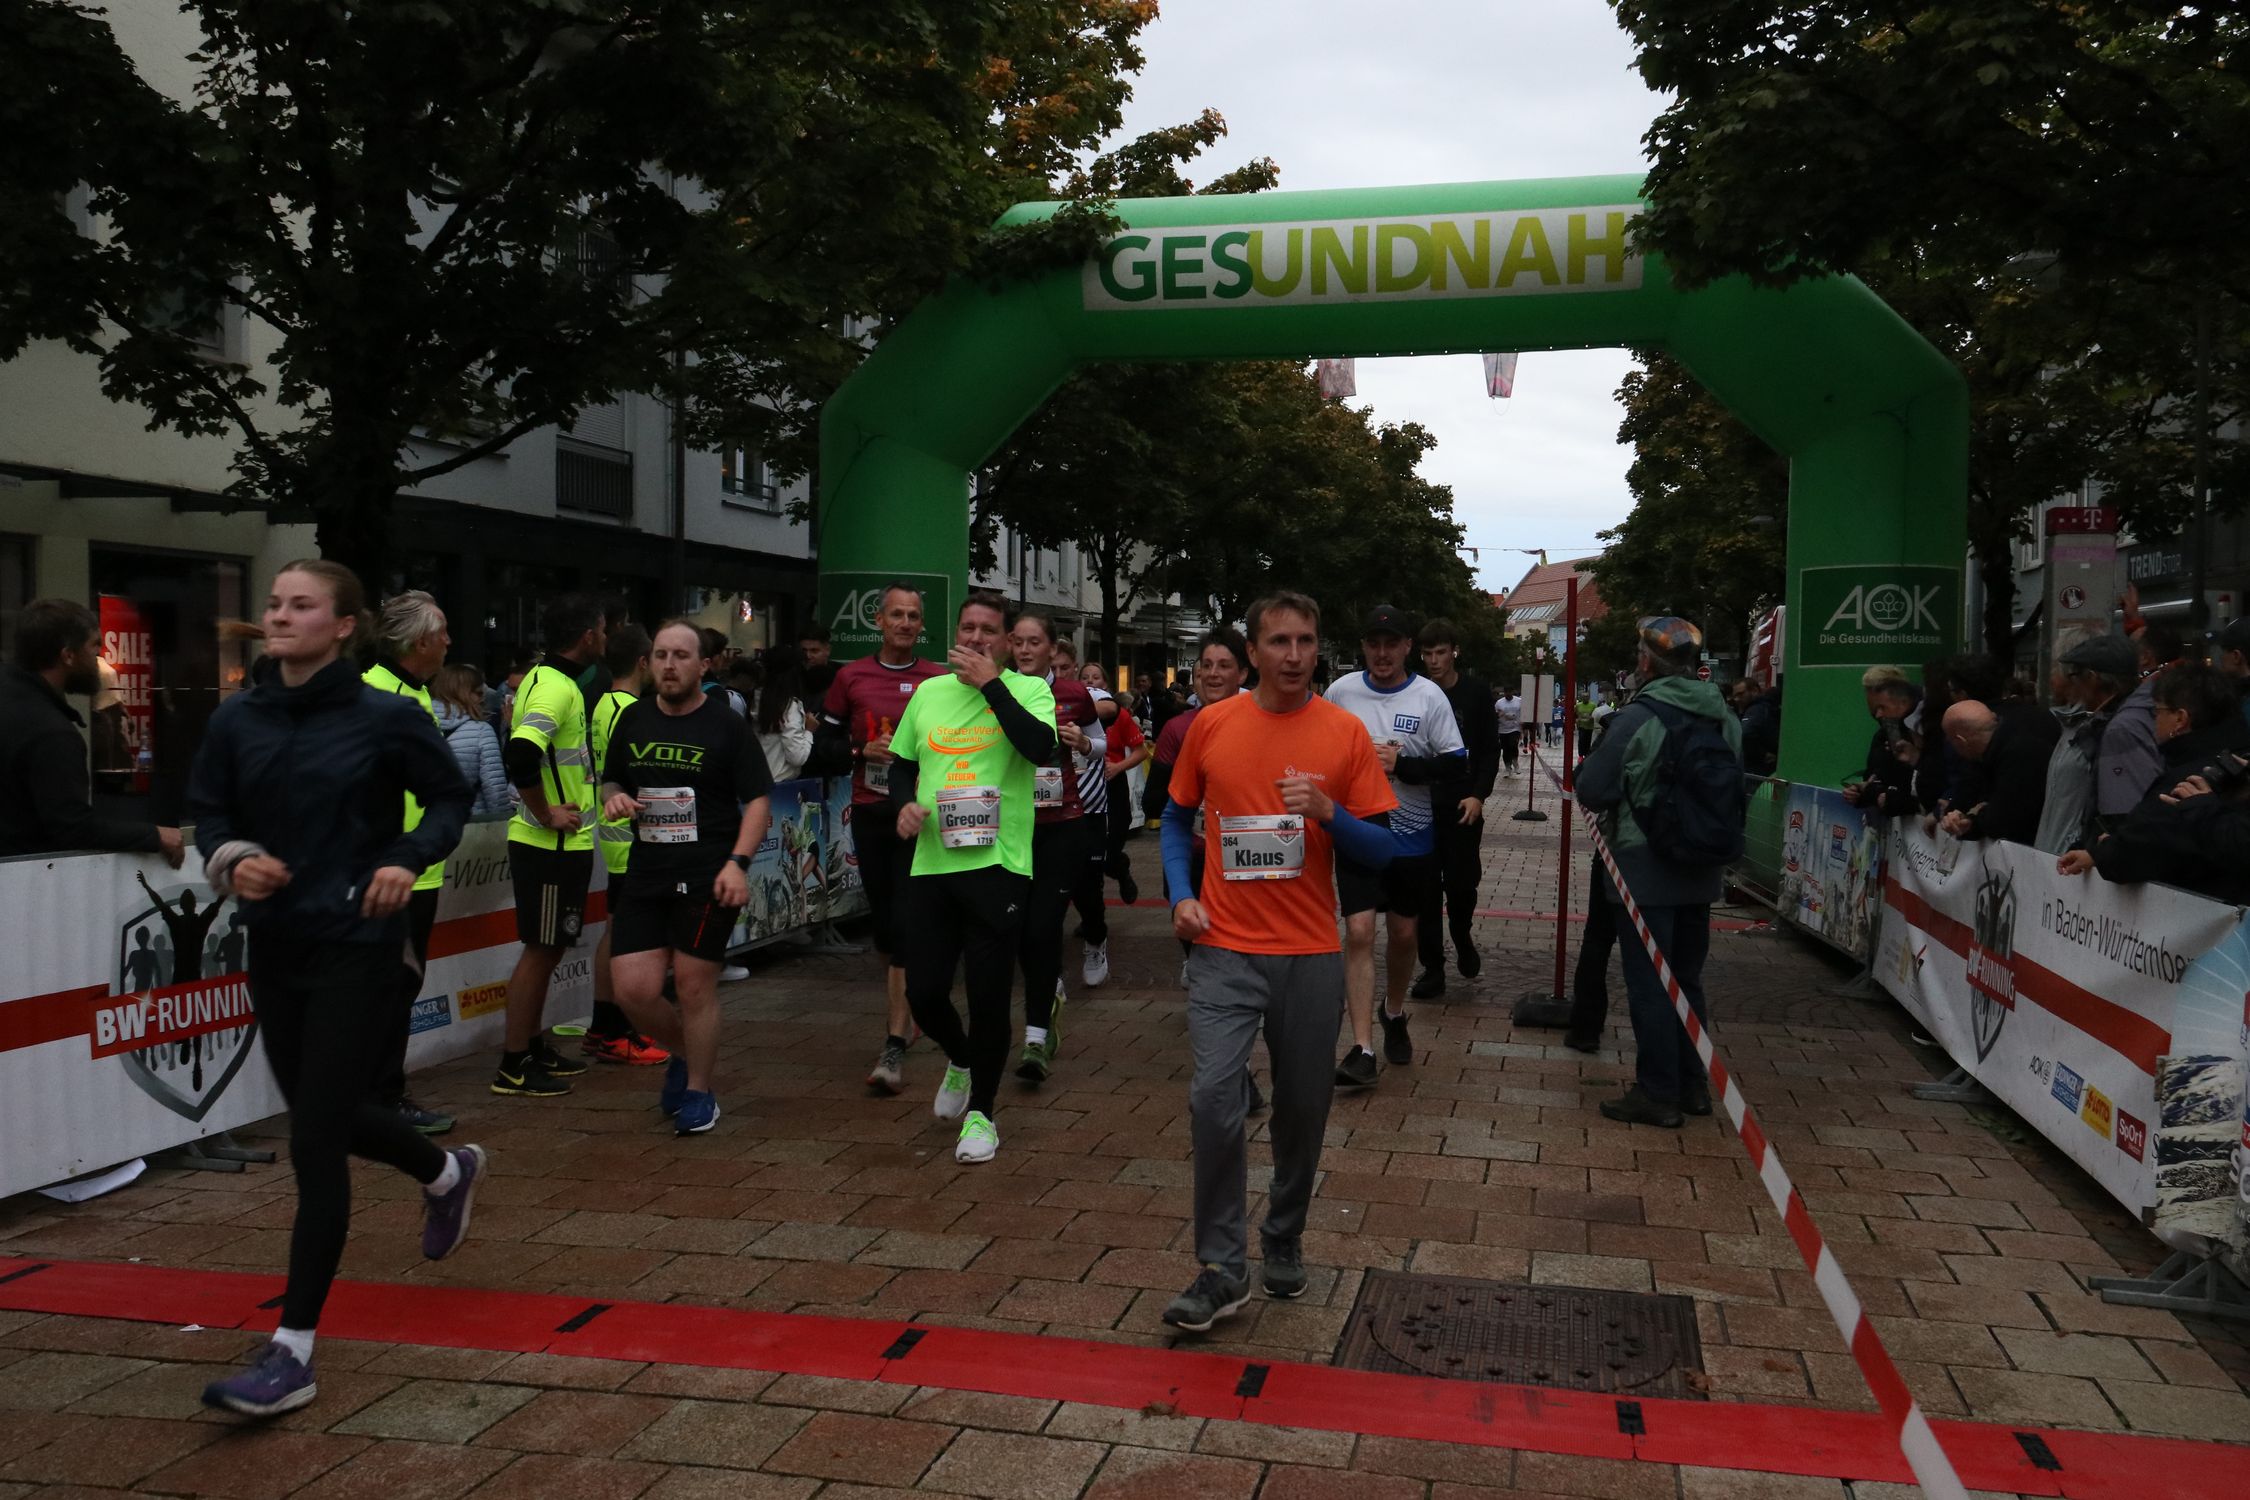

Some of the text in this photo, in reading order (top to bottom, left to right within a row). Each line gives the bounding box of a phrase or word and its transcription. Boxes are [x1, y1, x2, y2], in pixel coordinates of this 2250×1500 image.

[1099, 212, 1625, 302] GESUNDNAH
[1823, 584, 1941, 631] AOK
[104, 630, 151, 666] SALE
[1819, 633, 1836, 645] Die
[119, 673, 151, 706] ALE
[628, 741, 706, 766] VOLZ
[946, 773, 976, 782] STEUERN
[938, 803, 956, 813] 1719
[637, 811, 692, 827] Krzysztof
[945, 814, 991, 828] Gregor
[671, 834, 690, 842] 2107
[976, 837, 994, 846] 1719
[1222, 837, 1239, 847] 364
[1235, 849, 1285, 867] Klaus
[2041, 893, 2195, 984] in Baden-Württembe
[553, 959, 590, 985] S.COOL
[1968, 946, 2015, 1002] BW-RUNNING
[475, 985, 507, 1005] LOTTO
[2119, 1118, 2143, 1148] SpOrt
